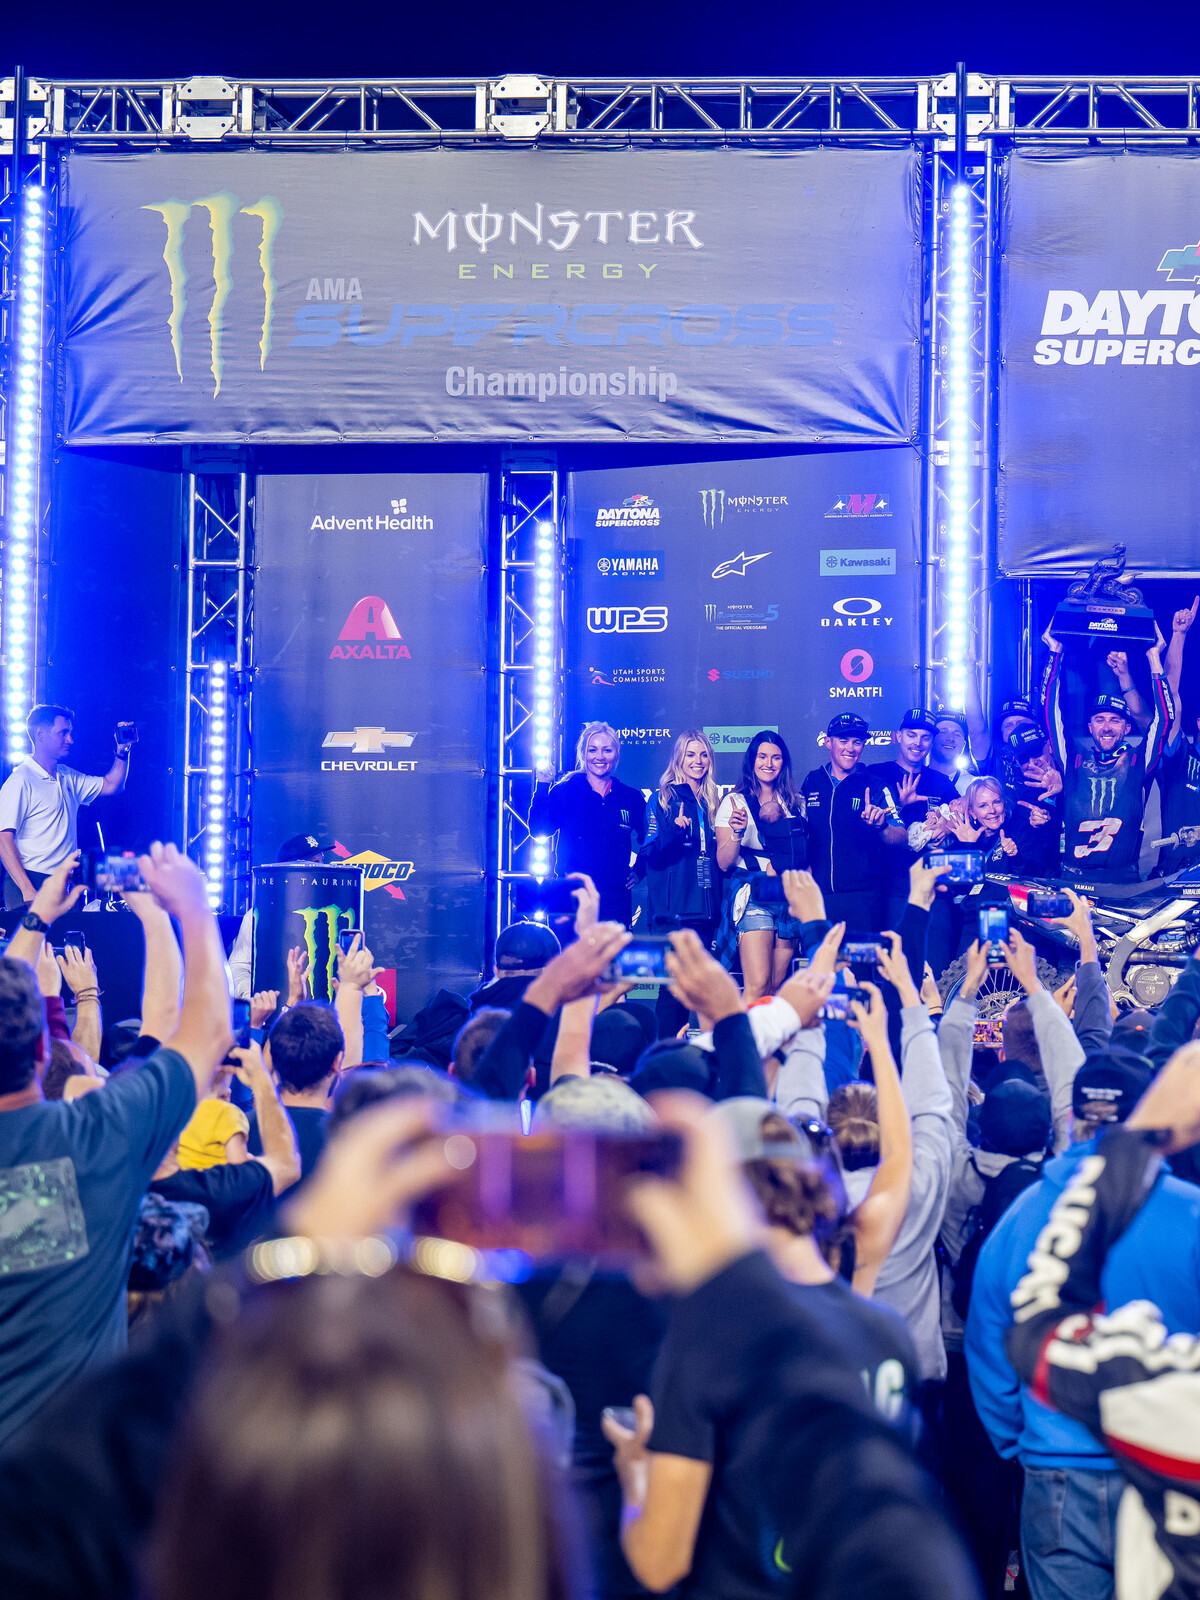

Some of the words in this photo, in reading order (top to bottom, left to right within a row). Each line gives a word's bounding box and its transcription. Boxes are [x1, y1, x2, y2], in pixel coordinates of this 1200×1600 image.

[412, 202, 704, 252] MONSTER
[459, 264, 660, 280] ENERGY
[305, 278, 363, 301] AMA
[286, 301, 838, 347] SUPERCROSS
[445, 366, 678, 402] Championship
[728, 495, 788, 507] MONSTER
[597, 508, 660, 520] DAYTONA
[311, 513, 433, 531] AdventHealth
[612, 558, 658, 571] YAMAHA
[840, 556, 890, 568] Kawasaki
[587, 607, 668, 633] WPS
[821, 617, 893, 627] OAKLEY
[329, 646, 411, 660] AXALTA
[722, 670, 774, 679] SUZUKI
[828, 687, 882, 698] SMARTFI
[722, 734, 753, 744] Kawa
[320, 760, 418, 772] CHEVROLET
[1074, 818, 1123, 858] 3
[301, 878, 358, 886] TAURINE
